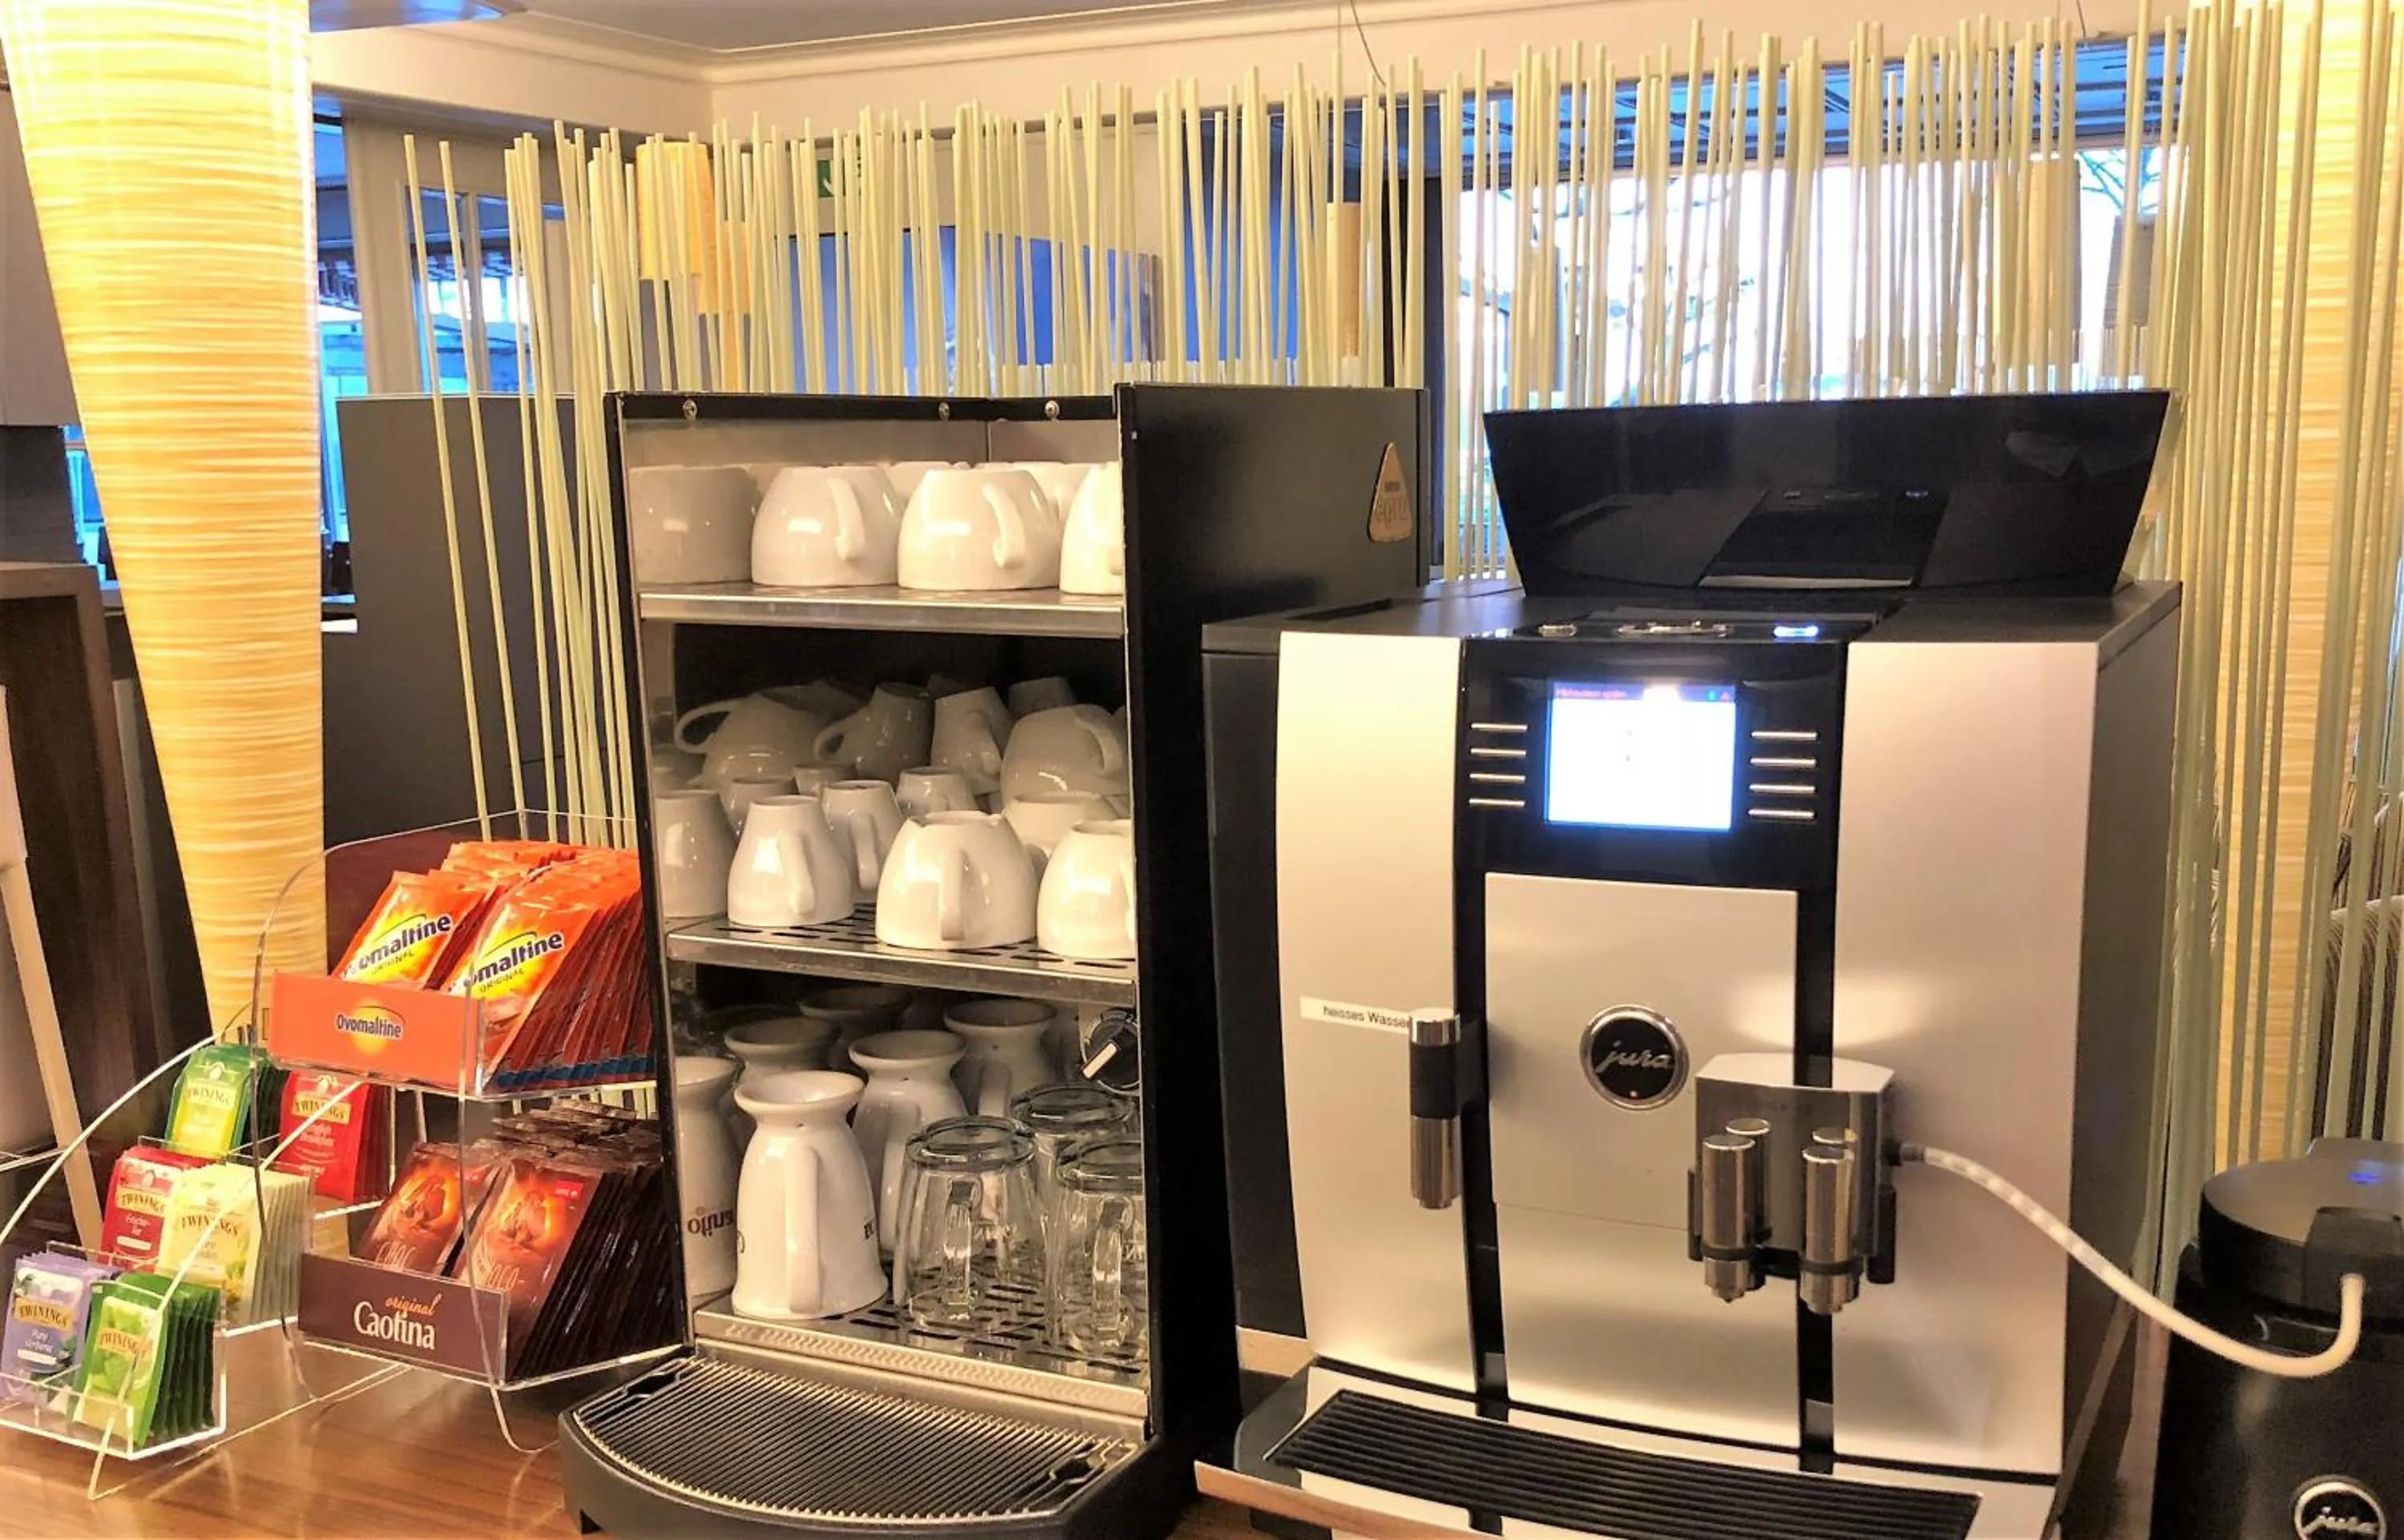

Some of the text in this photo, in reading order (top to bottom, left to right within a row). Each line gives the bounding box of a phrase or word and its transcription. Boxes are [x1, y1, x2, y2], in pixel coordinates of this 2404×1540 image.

[345, 915, 451, 976] omaltine
[448, 933, 563, 993] omaltine
[337, 1014, 401, 1038] Ovomaltine
[1595, 1040, 1674, 1074] jura
[295, 1100, 345, 1121] TWINNGS
[181, 1214, 239, 1237] TWINNGS
[19, 1304, 67, 1328] TWININGS
[385, 1292, 442, 1319] original
[353, 1300, 436, 1351] Caotina
